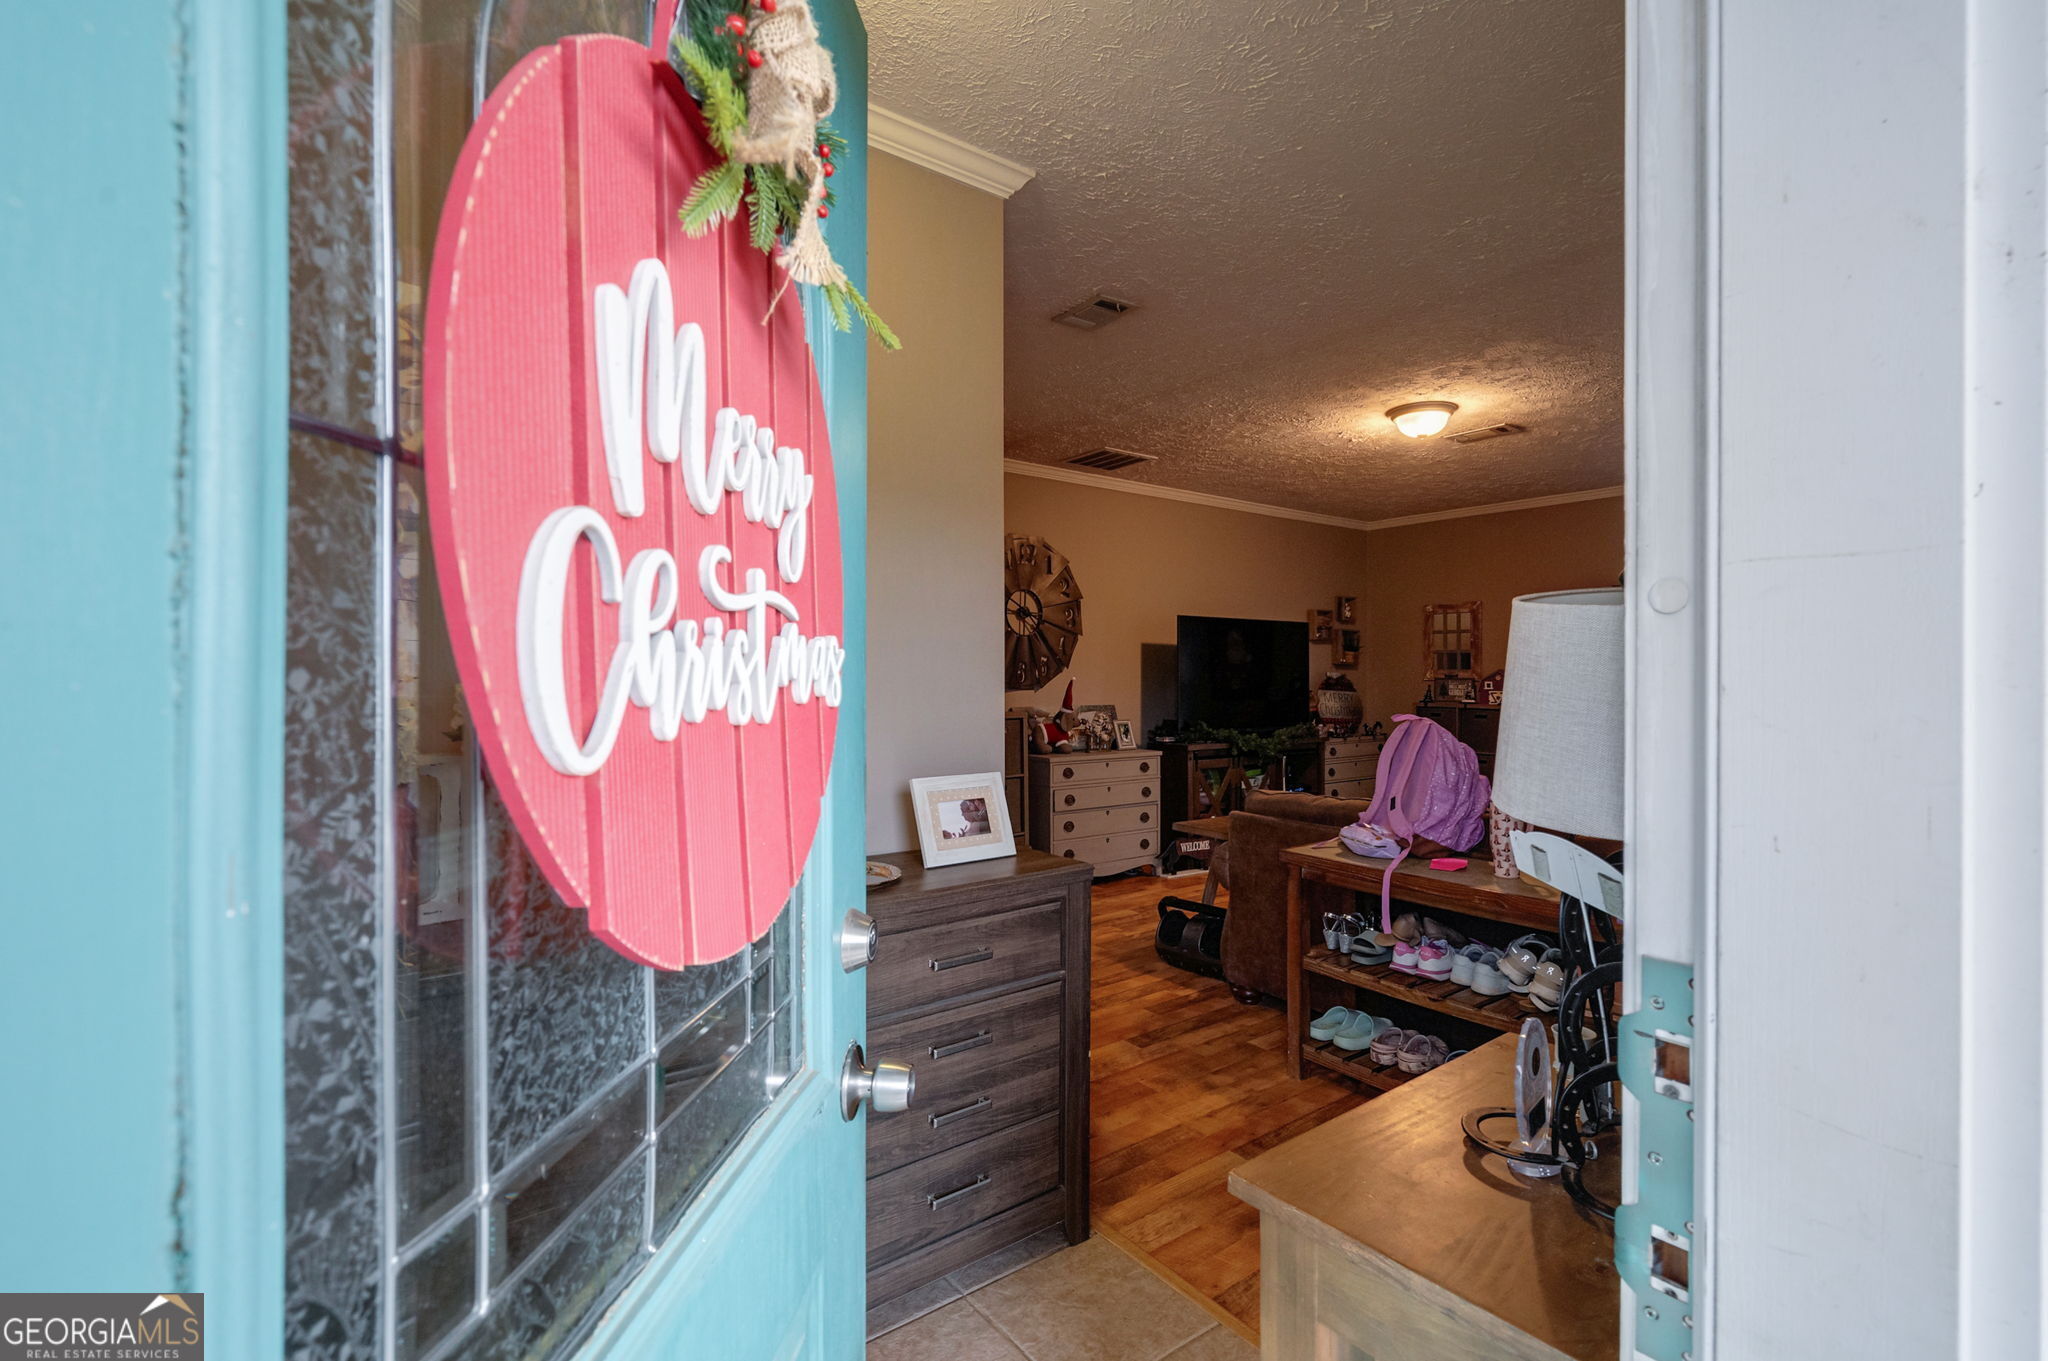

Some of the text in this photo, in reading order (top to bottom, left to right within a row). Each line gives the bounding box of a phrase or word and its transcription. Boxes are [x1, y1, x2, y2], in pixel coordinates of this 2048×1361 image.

[594, 257, 813, 583] Merry
[516, 505, 845, 776] Christmas
[1180, 840, 1210, 853] WELCOME
